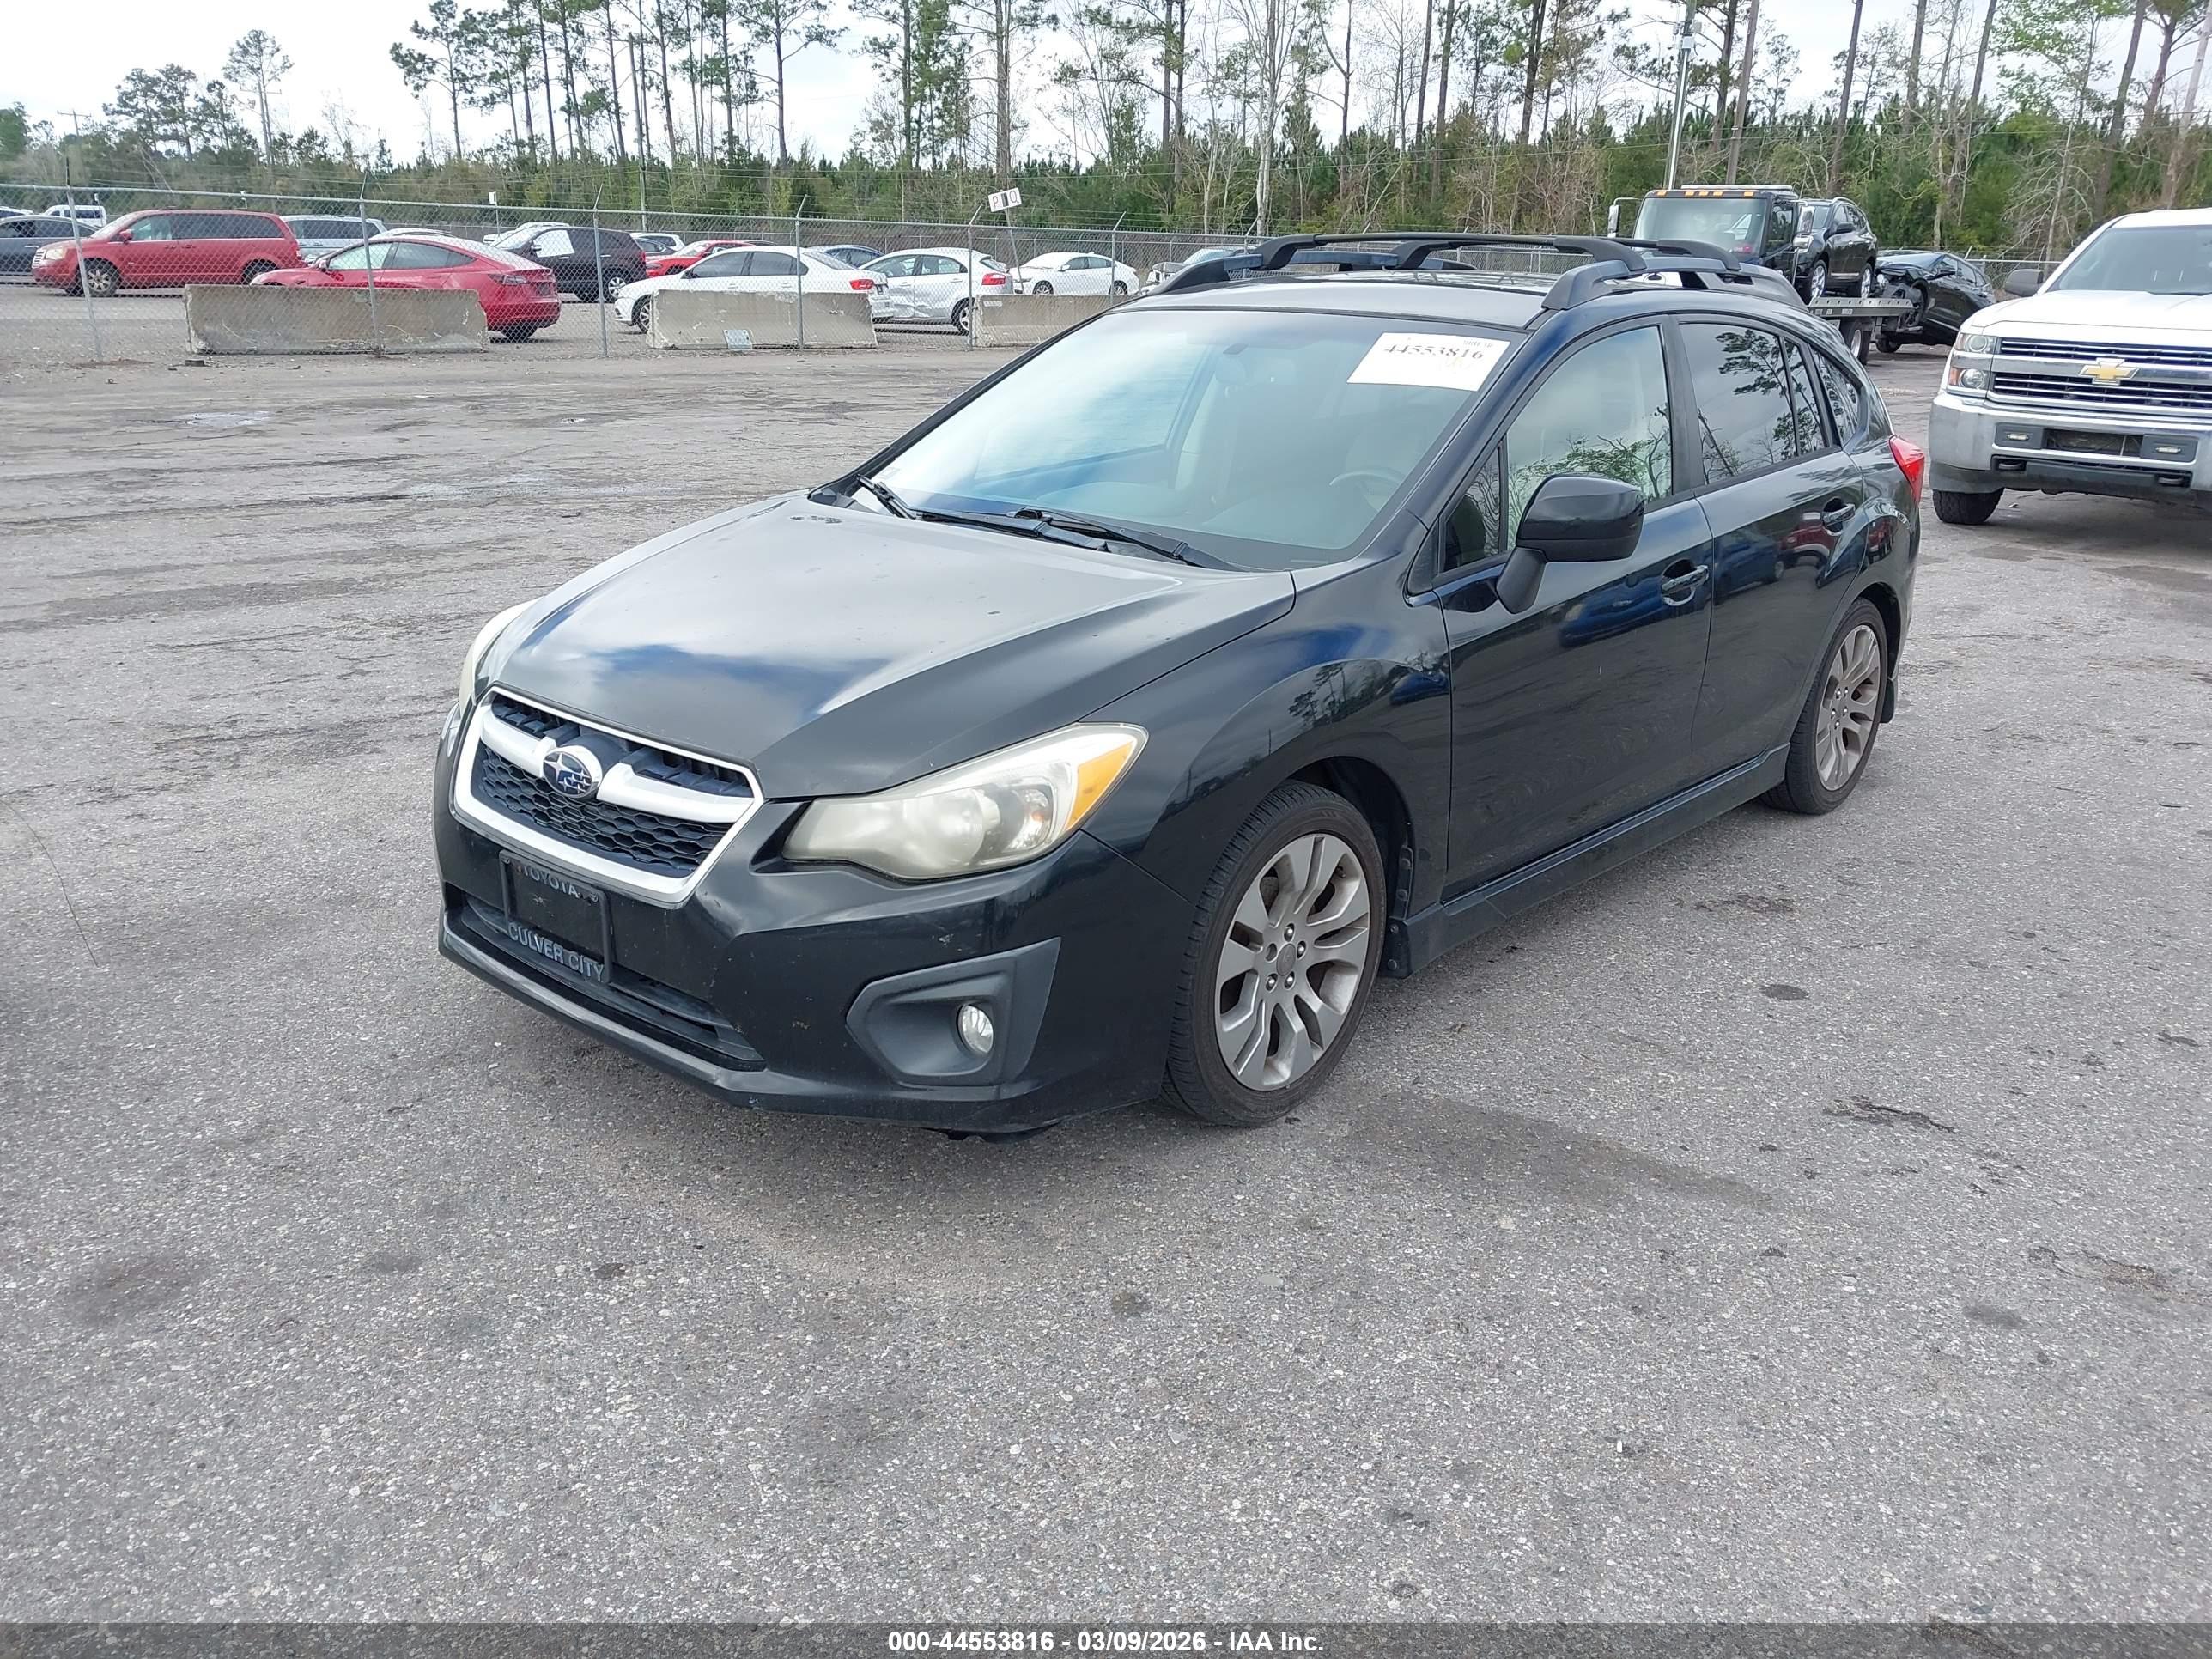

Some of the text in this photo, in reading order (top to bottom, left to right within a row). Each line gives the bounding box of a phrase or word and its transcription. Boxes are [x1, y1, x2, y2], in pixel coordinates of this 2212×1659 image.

[992, 190, 1019, 210] P Q
[1383, 344, 1484, 360] 44553816
[523, 865, 580, 899] TOYOTA
[508, 921, 605, 982] CULVER CITY
